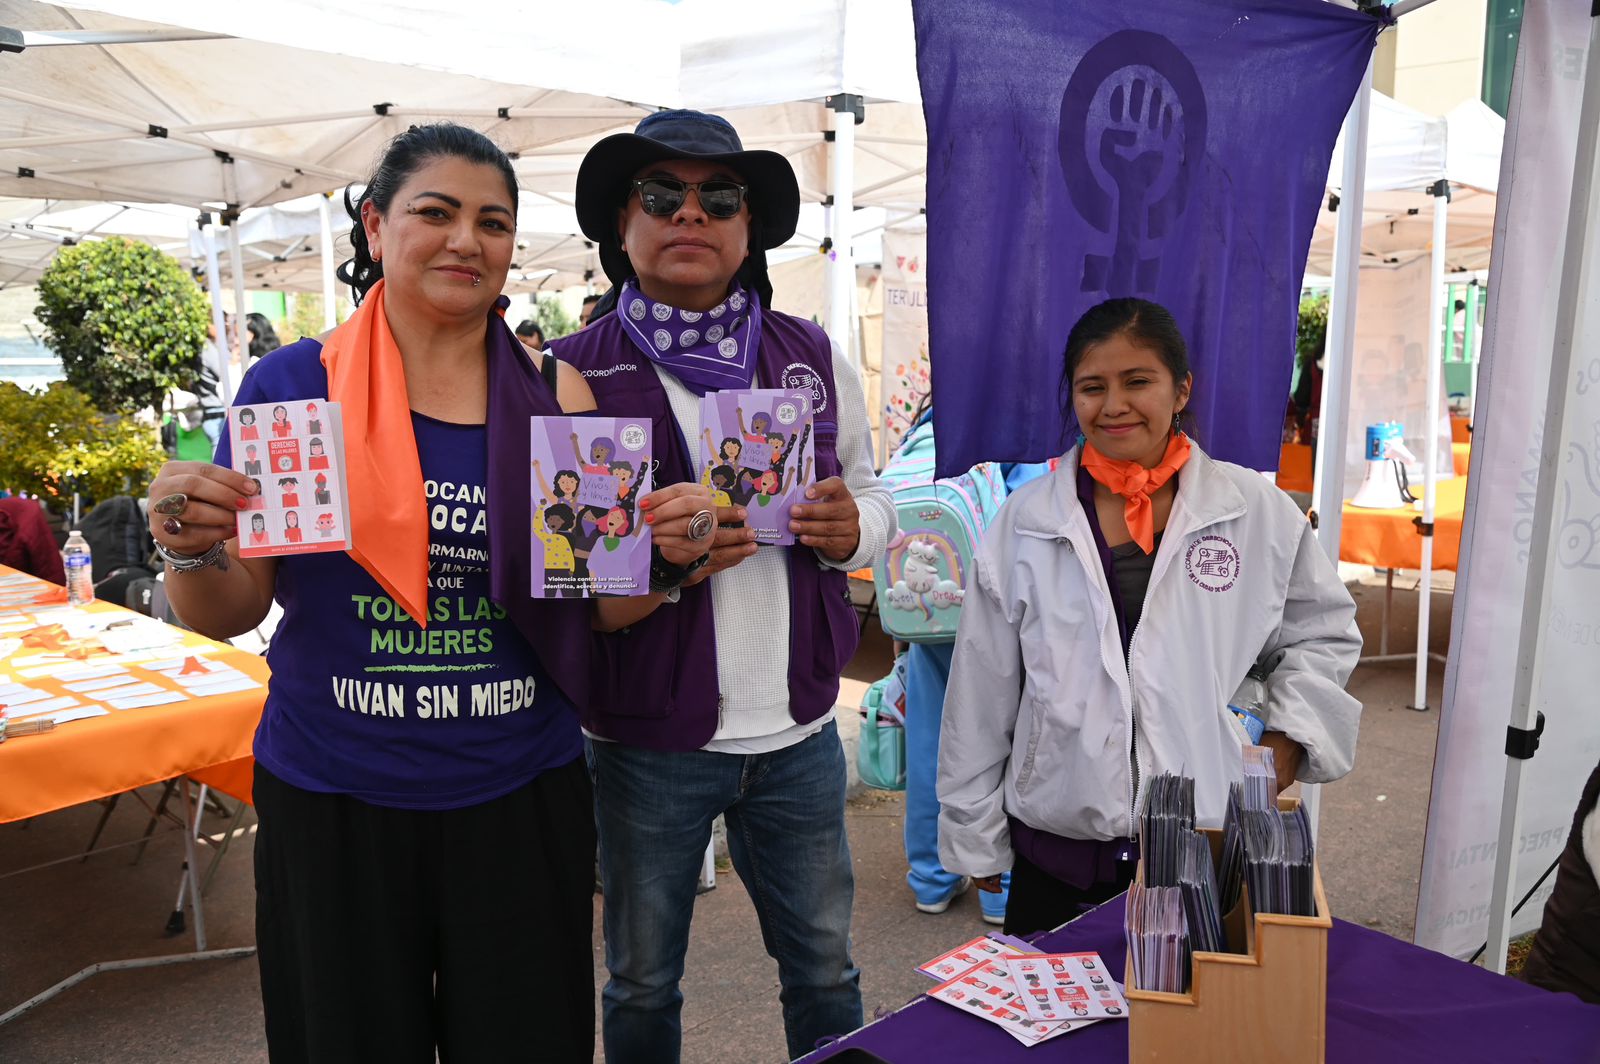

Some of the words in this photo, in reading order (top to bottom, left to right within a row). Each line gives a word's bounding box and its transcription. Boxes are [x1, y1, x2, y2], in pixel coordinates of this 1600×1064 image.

[887, 288, 927, 307] TERTULI
[424, 480, 486, 505] OCAN
[430, 504, 487, 536] OCA
[438, 562, 489, 574] JUNTA
[436, 577, 464, 591] QUE
[352, 594, 450, 622] TODS
[458, 596, 508, 622] LAS
[371, 628, 493, 655] MUJERES
[333, 676, 405, 718] VIVAN
[416, 685, 459, 719] SIN
[471, 675, 536, 717] MIEDO
